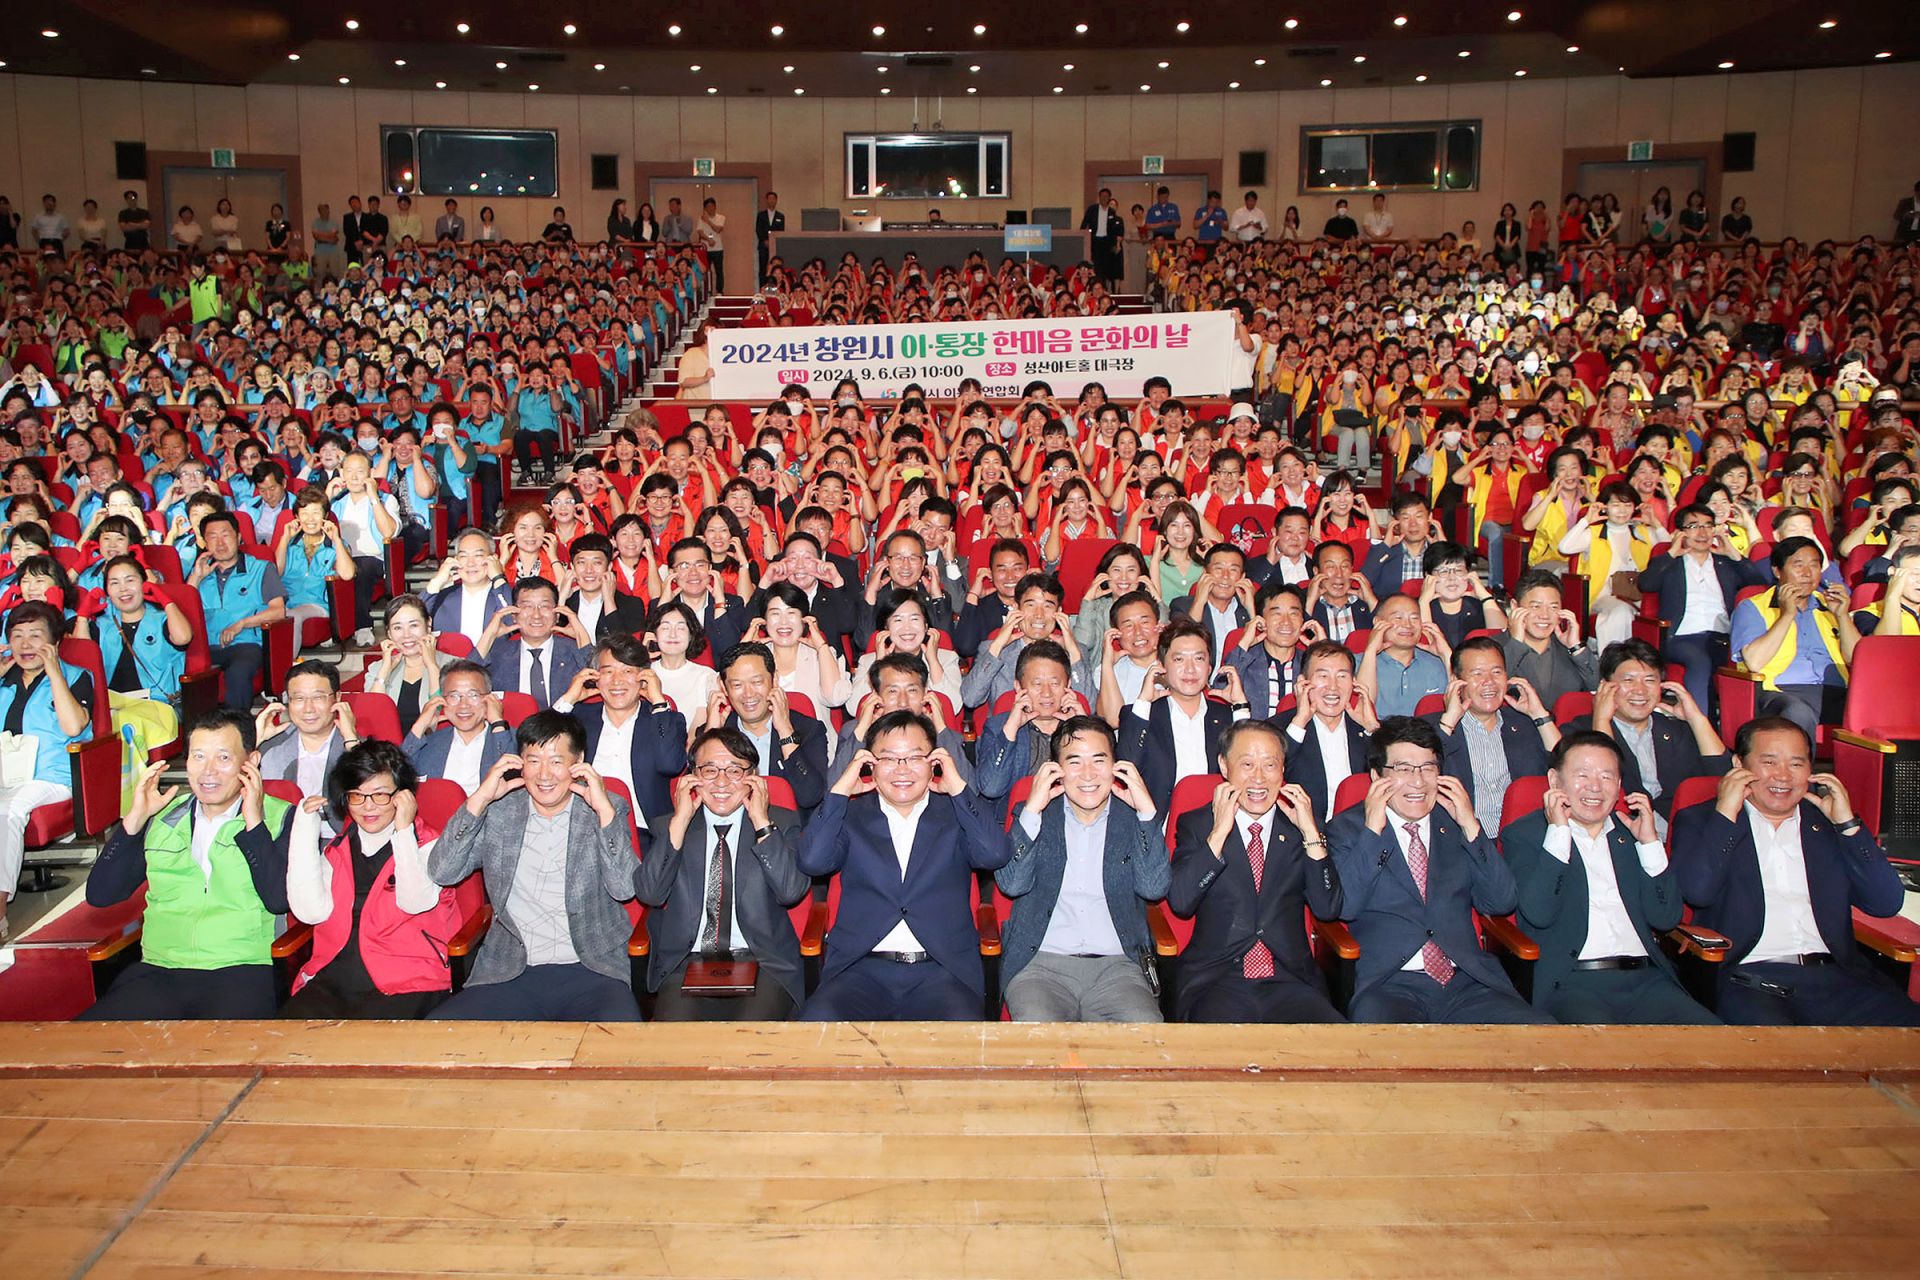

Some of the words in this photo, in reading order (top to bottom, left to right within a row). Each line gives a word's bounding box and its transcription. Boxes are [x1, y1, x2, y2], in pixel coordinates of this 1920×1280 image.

[721, 342, 809, 365] 2024년
[814, 334, 893, 362] 창원시
[992, 329, 1073, 356] 한마음
[1080, 325, 1158, 352] 문화의
[1165, 323, 1191, 349] 날
[921, 364, 964, 379] 10:00
[989, 363, 1013, 375] 장소
[1024, 358, 1091, 375] 성산아트홀
[1095, 357, 1135, 372] 대극장
[782, 370, 805, 383] 일시
